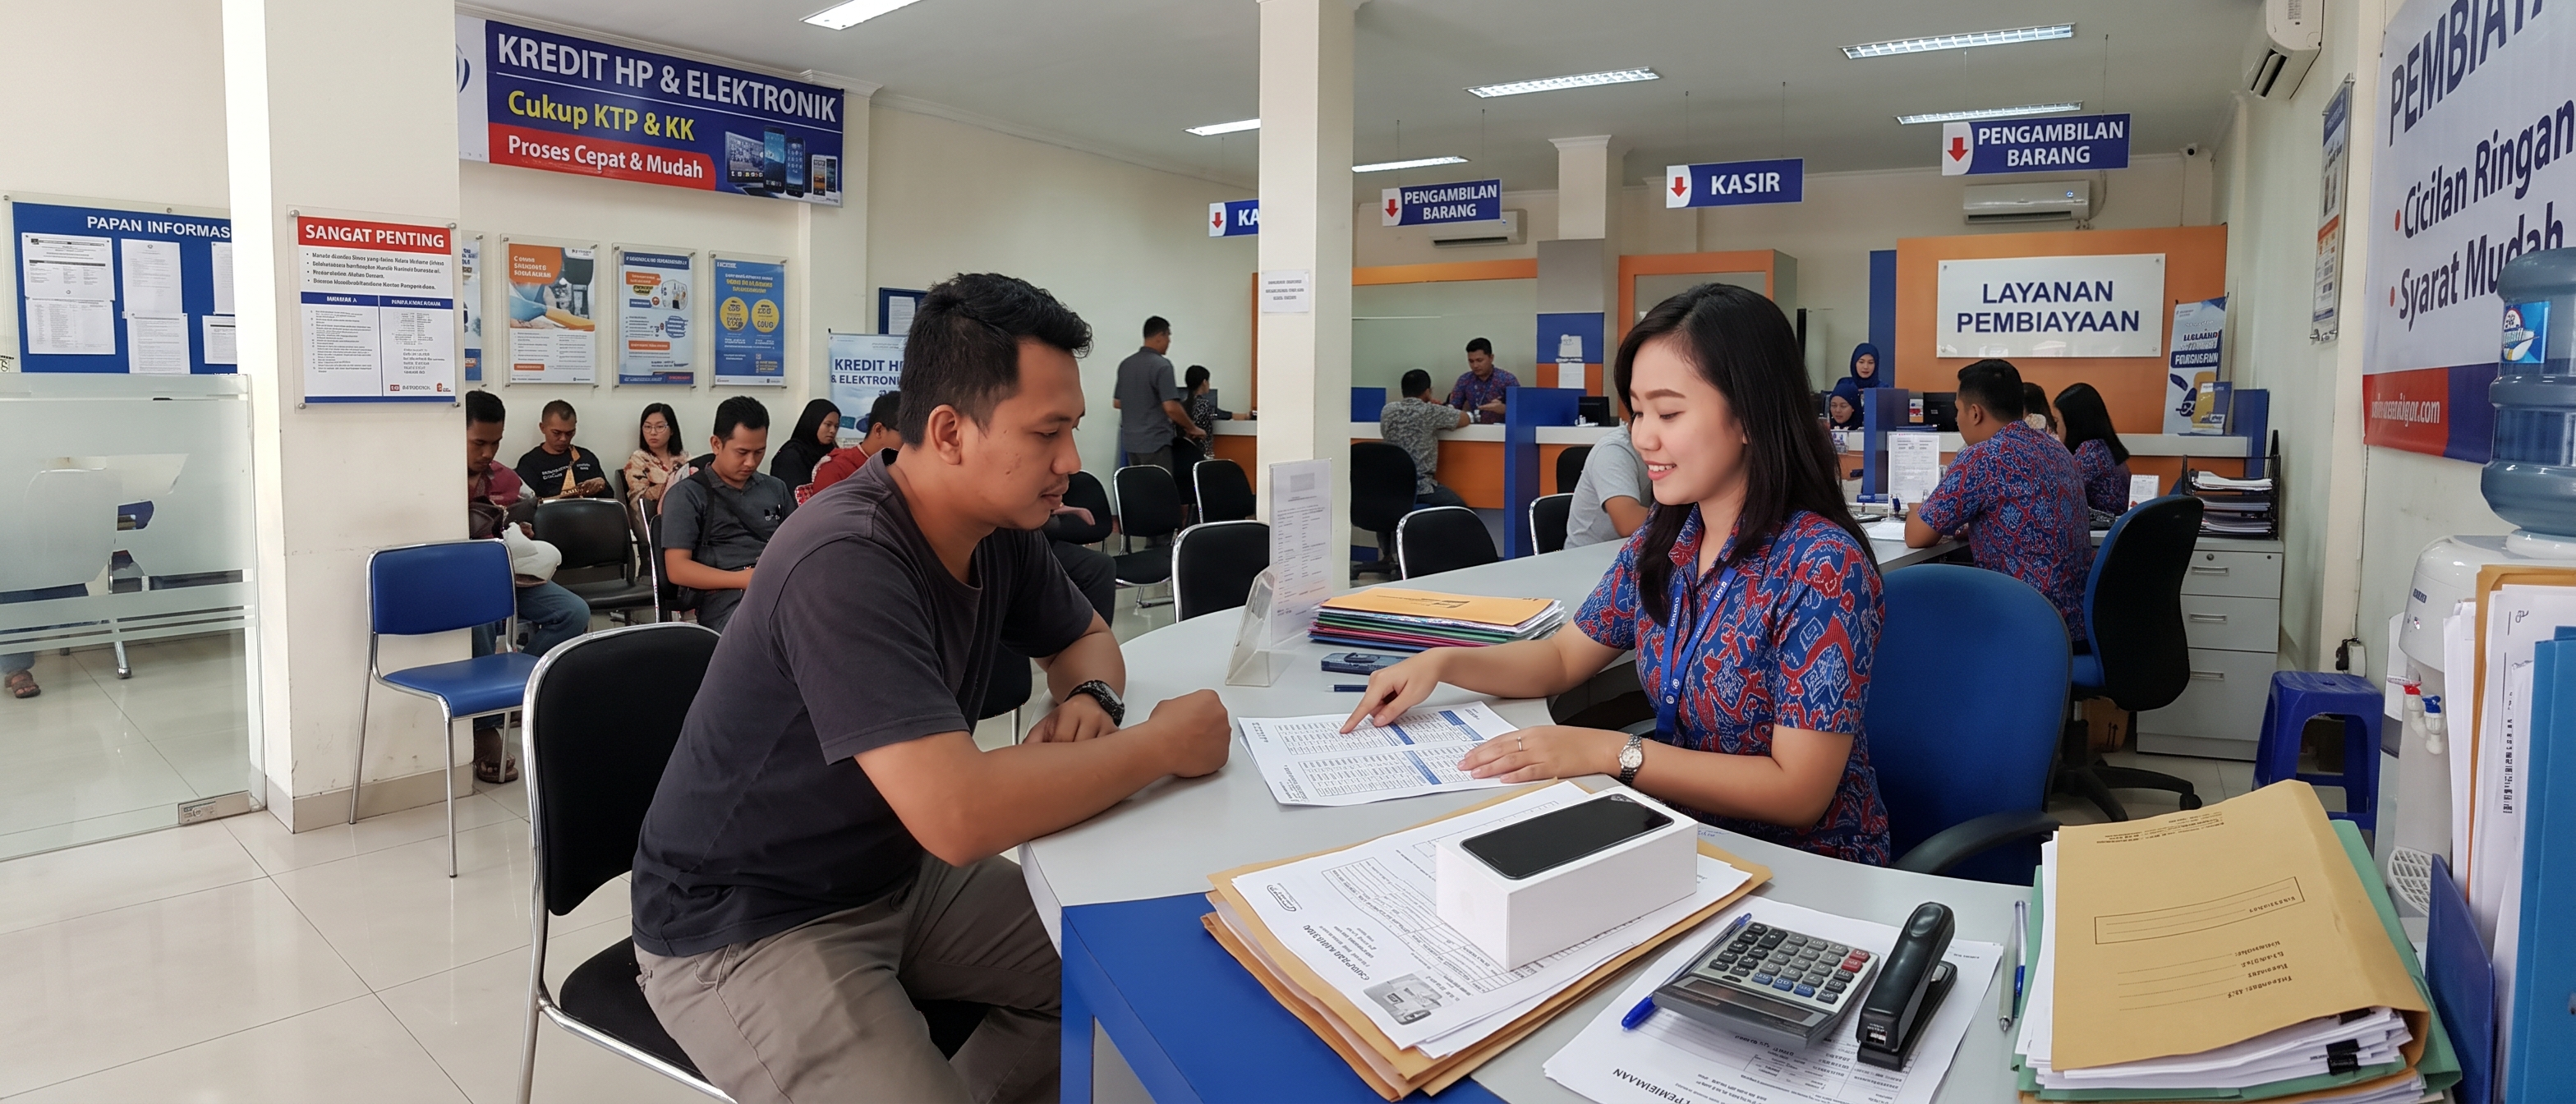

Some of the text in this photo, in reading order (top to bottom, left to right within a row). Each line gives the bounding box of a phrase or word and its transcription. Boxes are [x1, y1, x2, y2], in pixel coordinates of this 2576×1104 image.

[498, 33, 836, 122] KREDIT HP & ELEKTRONIK
[2390, 0, 2542, 148] PEMBIA
[508, 90, 695, 141] Cukup KTP & KK
[1978, 121, 2123, 145] PENGAMBILAN
[508, 135, 703, 178] Proses Cepat & Mudah
[2007, 145, 2091, 167] BARANG
[2404, 99, 2574, 239] Cicilan Ringan
[1405, 184, 1497, 205] PENGAMBILAN
[1711, 172, 1781, 196] KASIR
[1423, 203, 1476, 220] BARANG
[87, 216, 231, 238] PAPAN INFORMAS
[306, 224, 444, 248] SANGAT PENTING
[1982, 280, 2113, 304] LAYANAN
[2399, 251, 2459, 332] Syarat
[1957, 310, 2139, 334] PEMBIAYAAN
[835, 359, 885, 371] KREDIT
[830, 375, 837, 384] &
